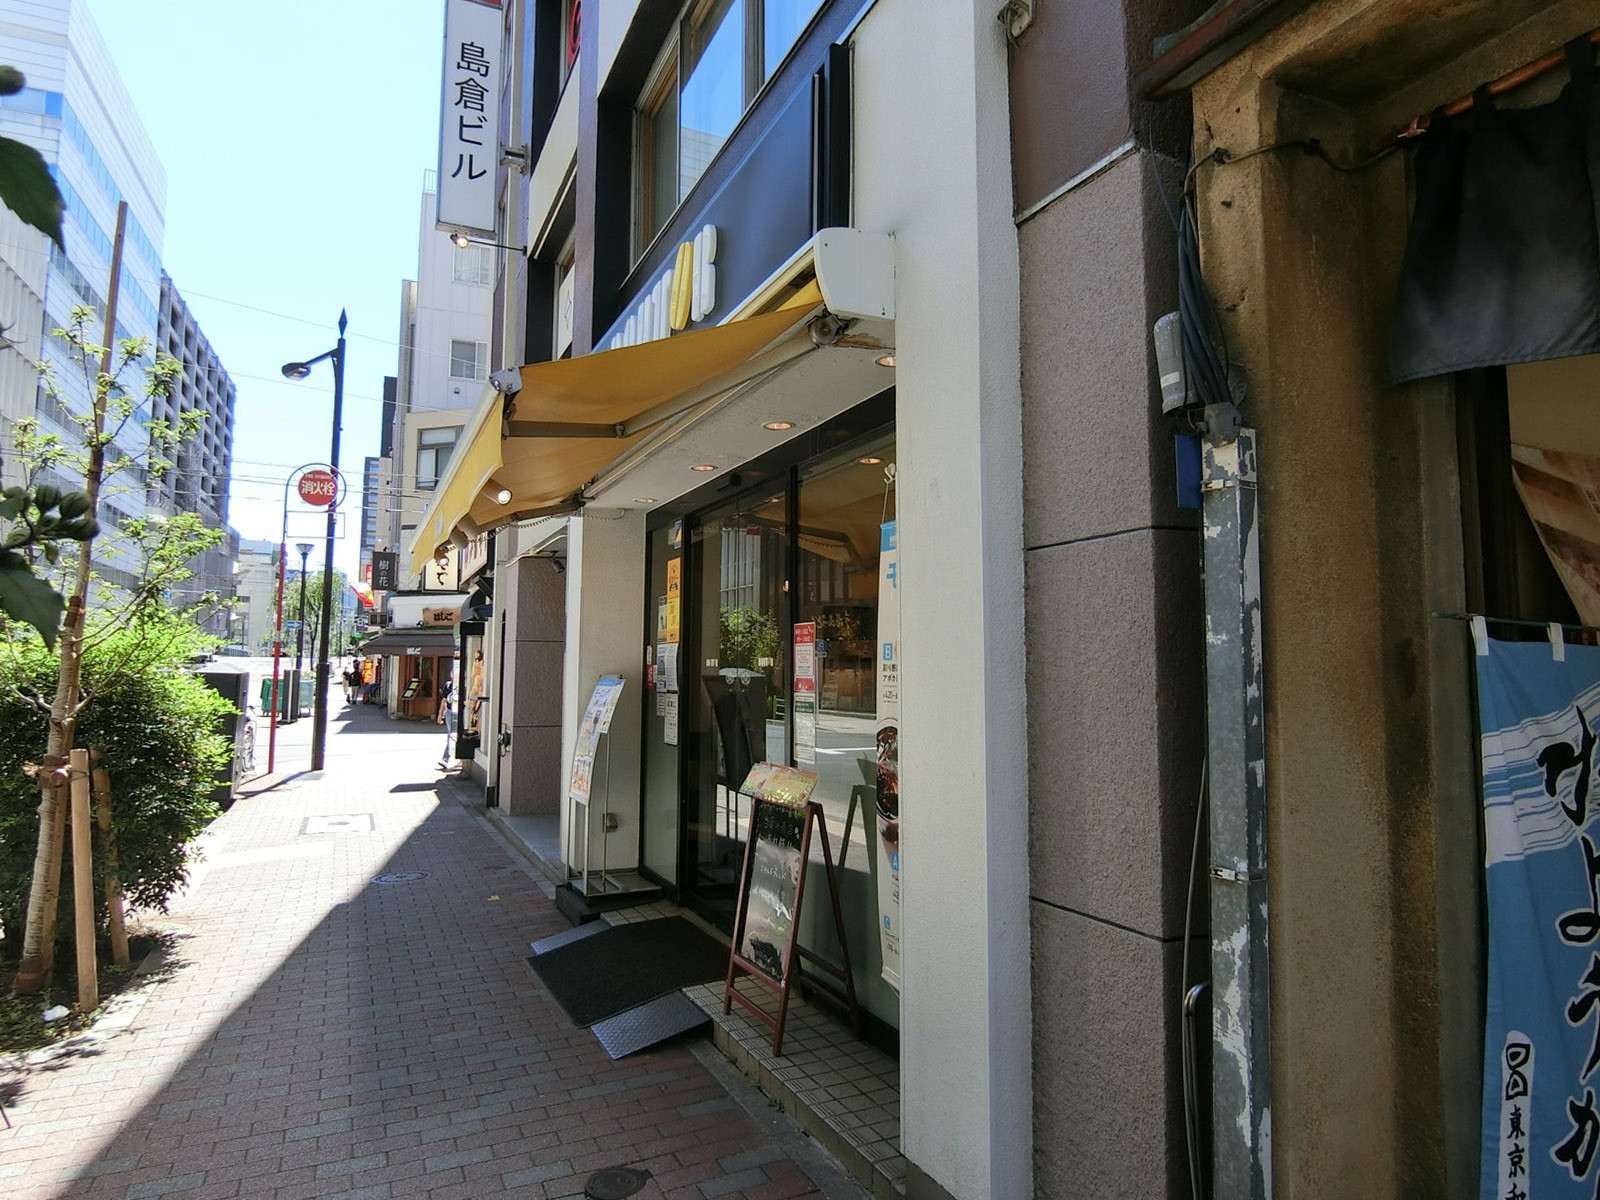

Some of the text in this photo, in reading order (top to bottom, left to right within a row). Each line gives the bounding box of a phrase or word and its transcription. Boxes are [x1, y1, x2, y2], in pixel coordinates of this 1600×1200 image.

[451, 41, 491, 181] 島倉ビル
[301, 480, 336, 496] 消火栓
[378, 559, 390, 587] 樹の花
[433, 611, 454, 622] はしご
